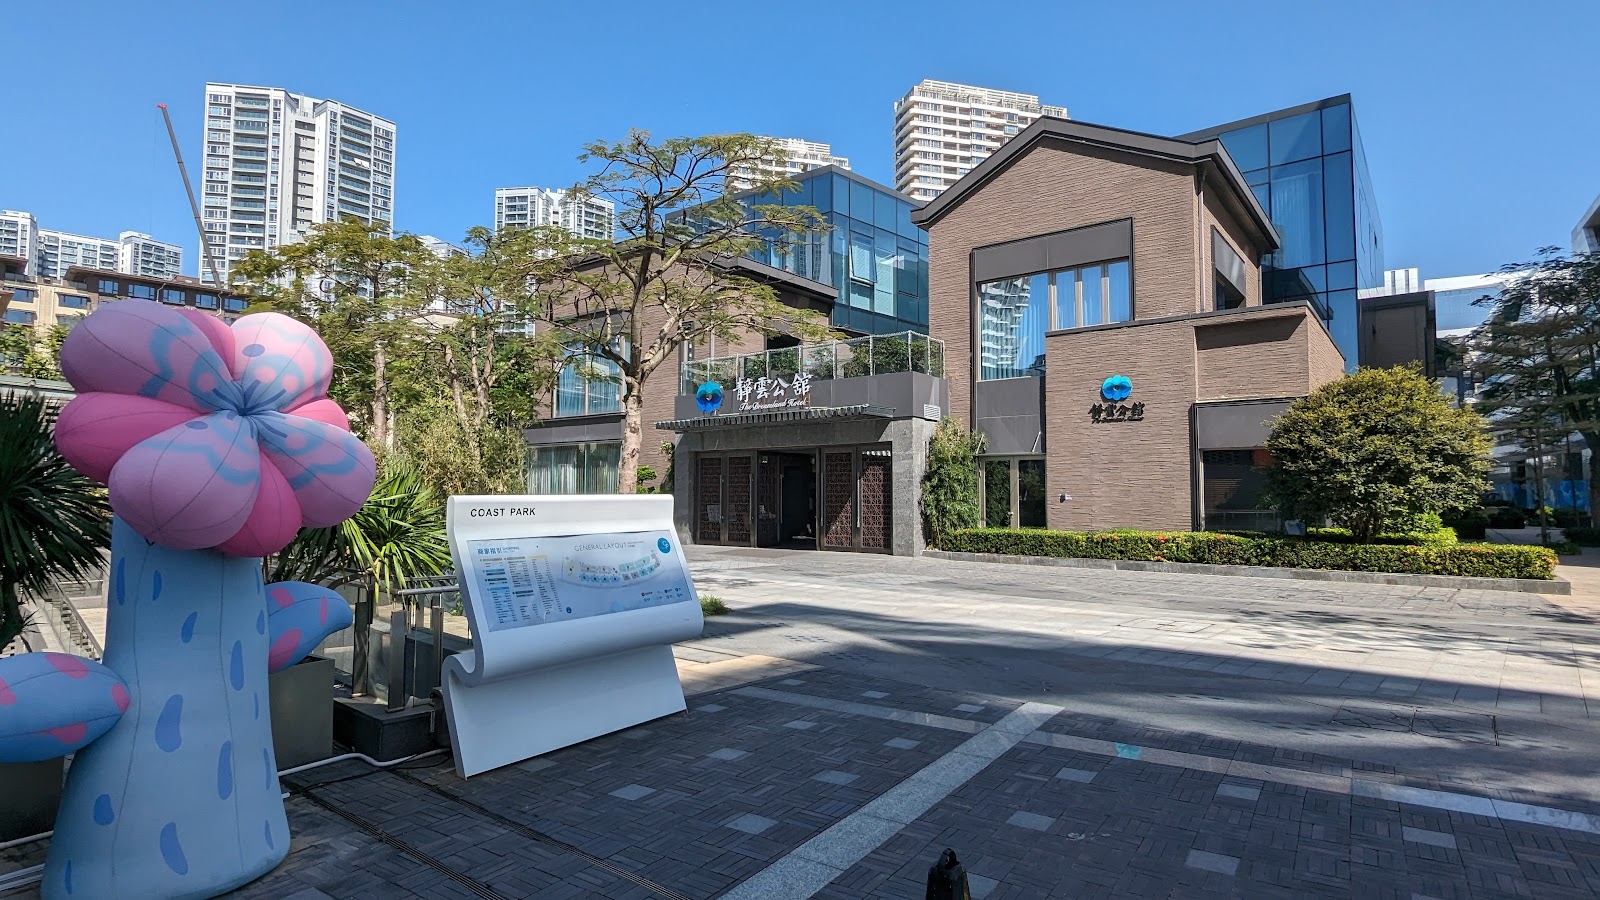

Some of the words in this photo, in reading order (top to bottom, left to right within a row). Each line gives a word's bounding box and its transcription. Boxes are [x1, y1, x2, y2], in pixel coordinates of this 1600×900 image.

[739, 402, 752, 411] The
[752, 398, 787, 410] Dreamland
[470, 508, 505, 517] COAST
[510, 507, 536, 516] PARK
[574, 544, 602, 552] GENERAL
[604, 542, 627, 550] LAYOUT
